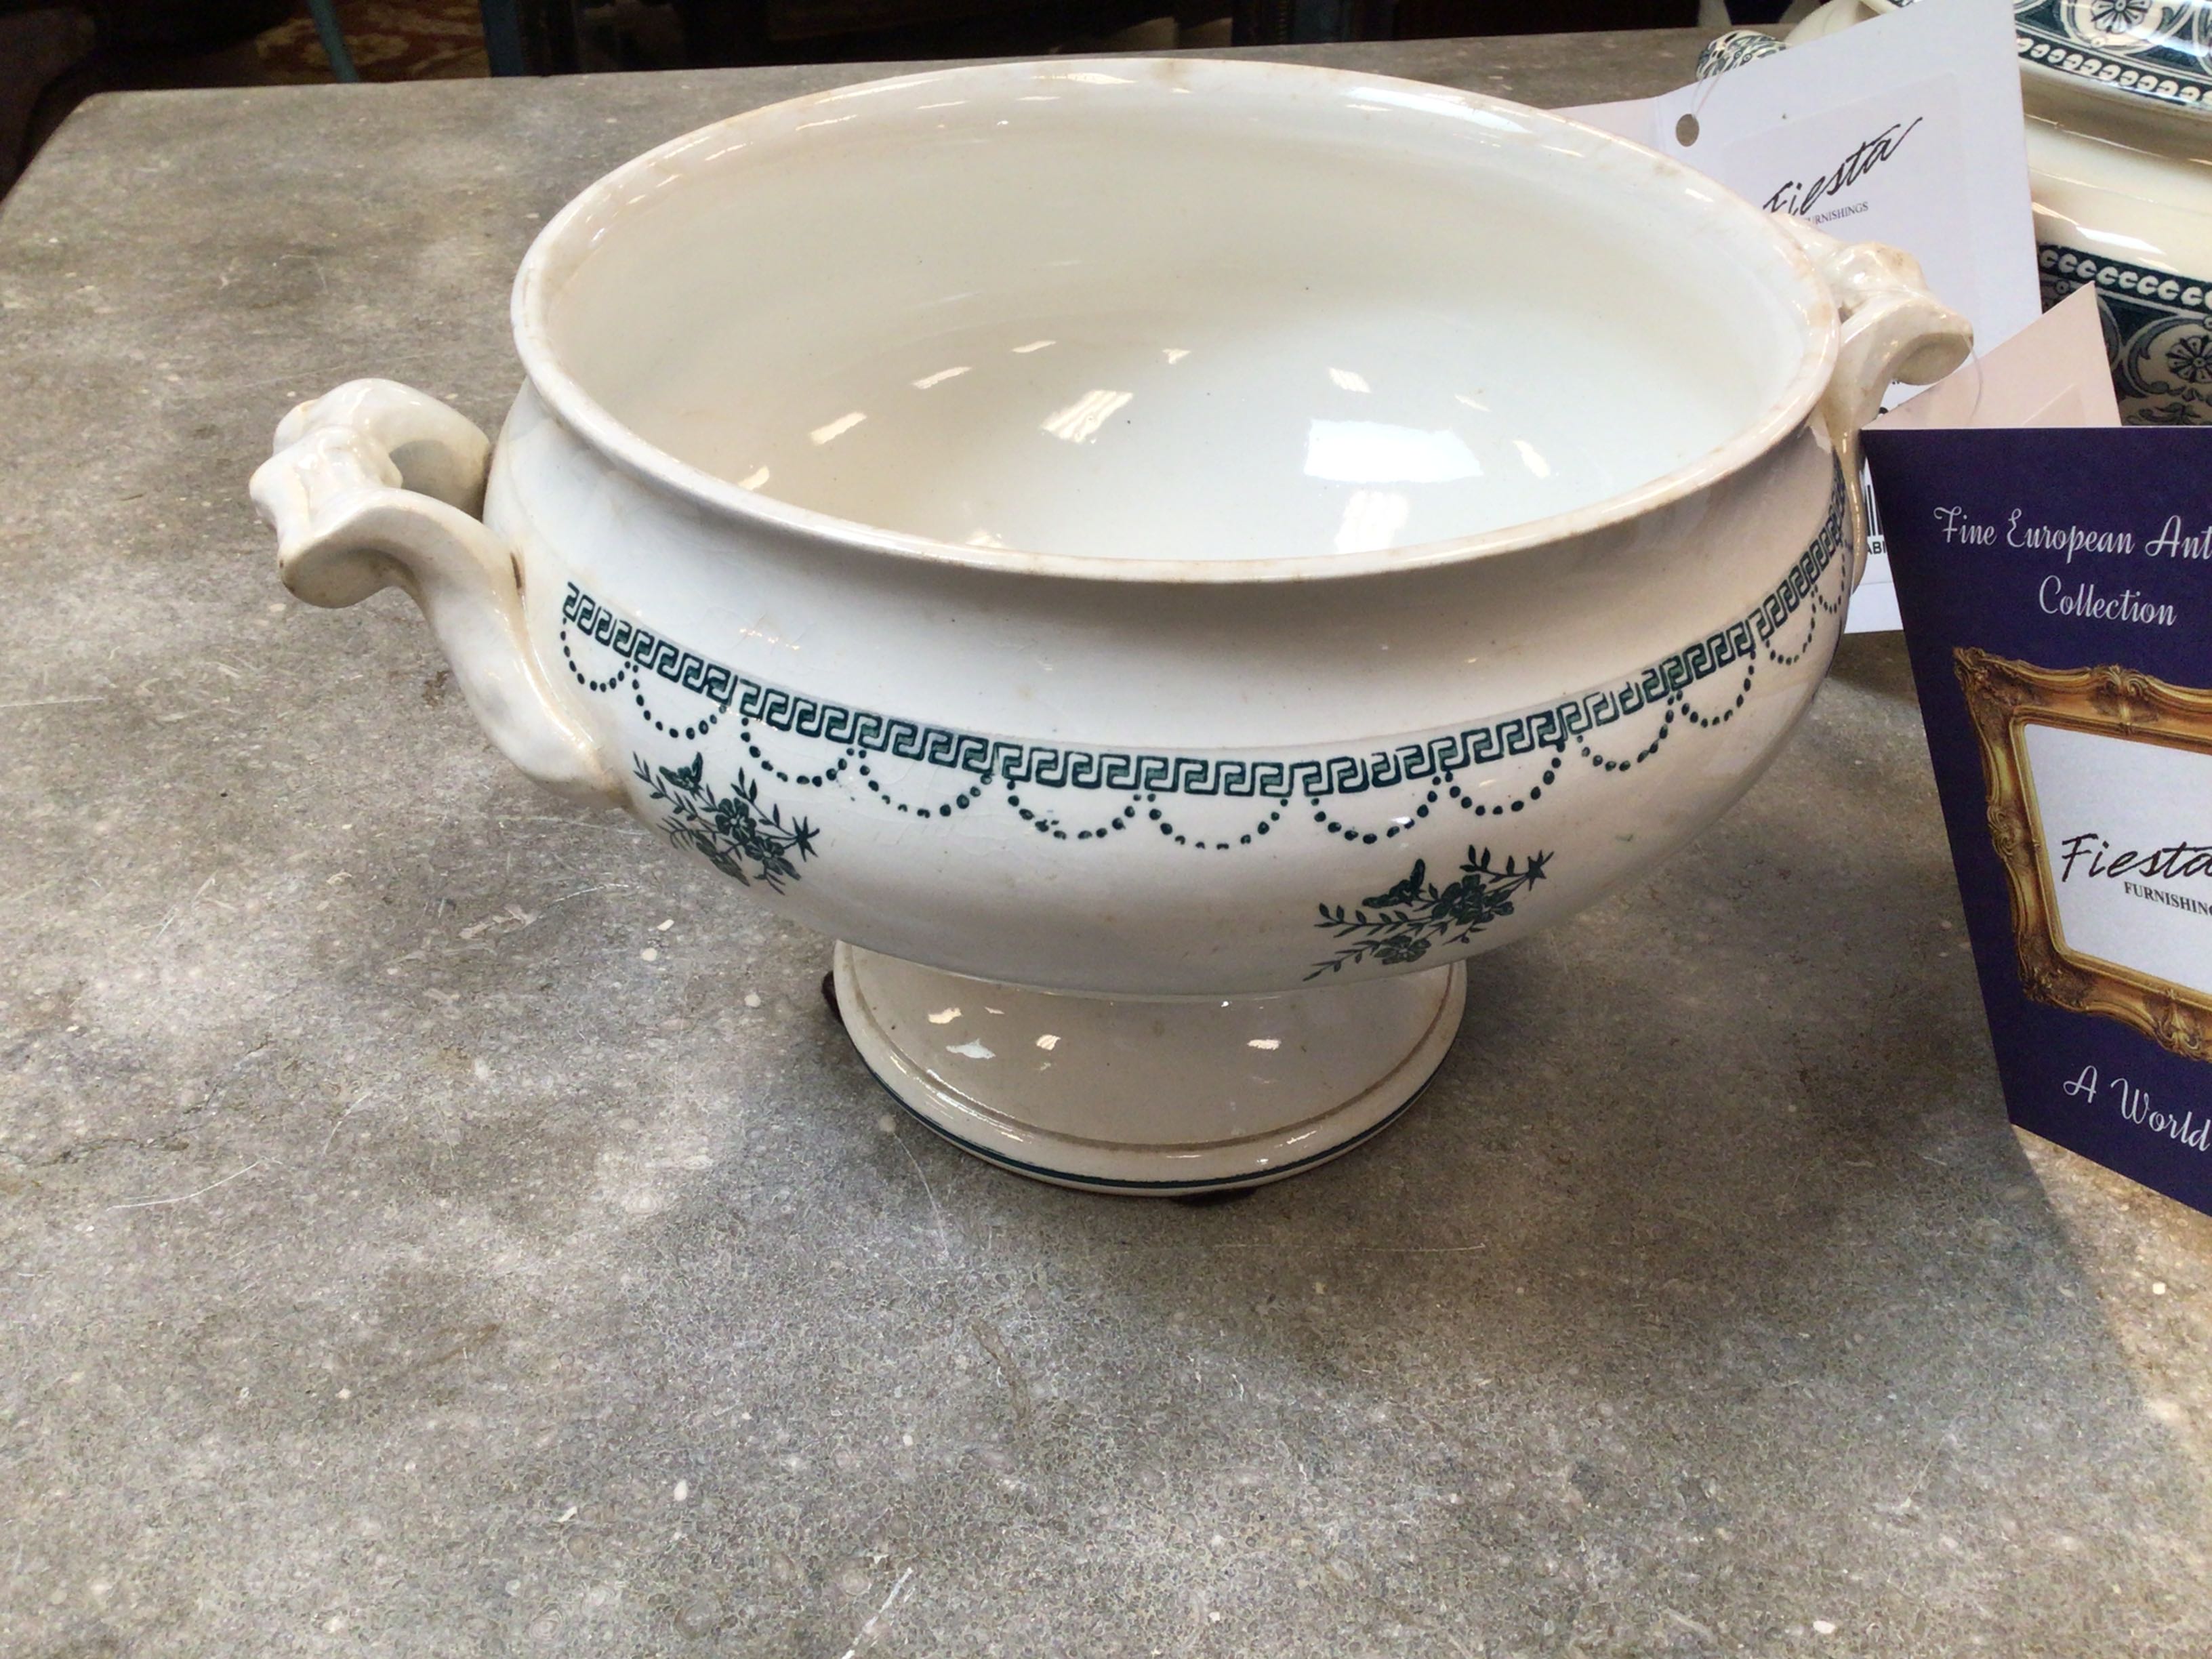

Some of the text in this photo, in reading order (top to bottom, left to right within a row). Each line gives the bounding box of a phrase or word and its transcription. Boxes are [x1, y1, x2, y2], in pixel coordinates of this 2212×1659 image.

[1763, 117, 1923, 216] Fiesta
[1803, 201, 1870, 225] RNISHINGS
[1933, 506, 1997, 546] Fine
[2007, 508, 2135, 565] European
[2039, 575, 2177, 626] Collection
[2062, 833, 2212, 882] Fiesta
[2063, 1065, 2211, 1152] A World
